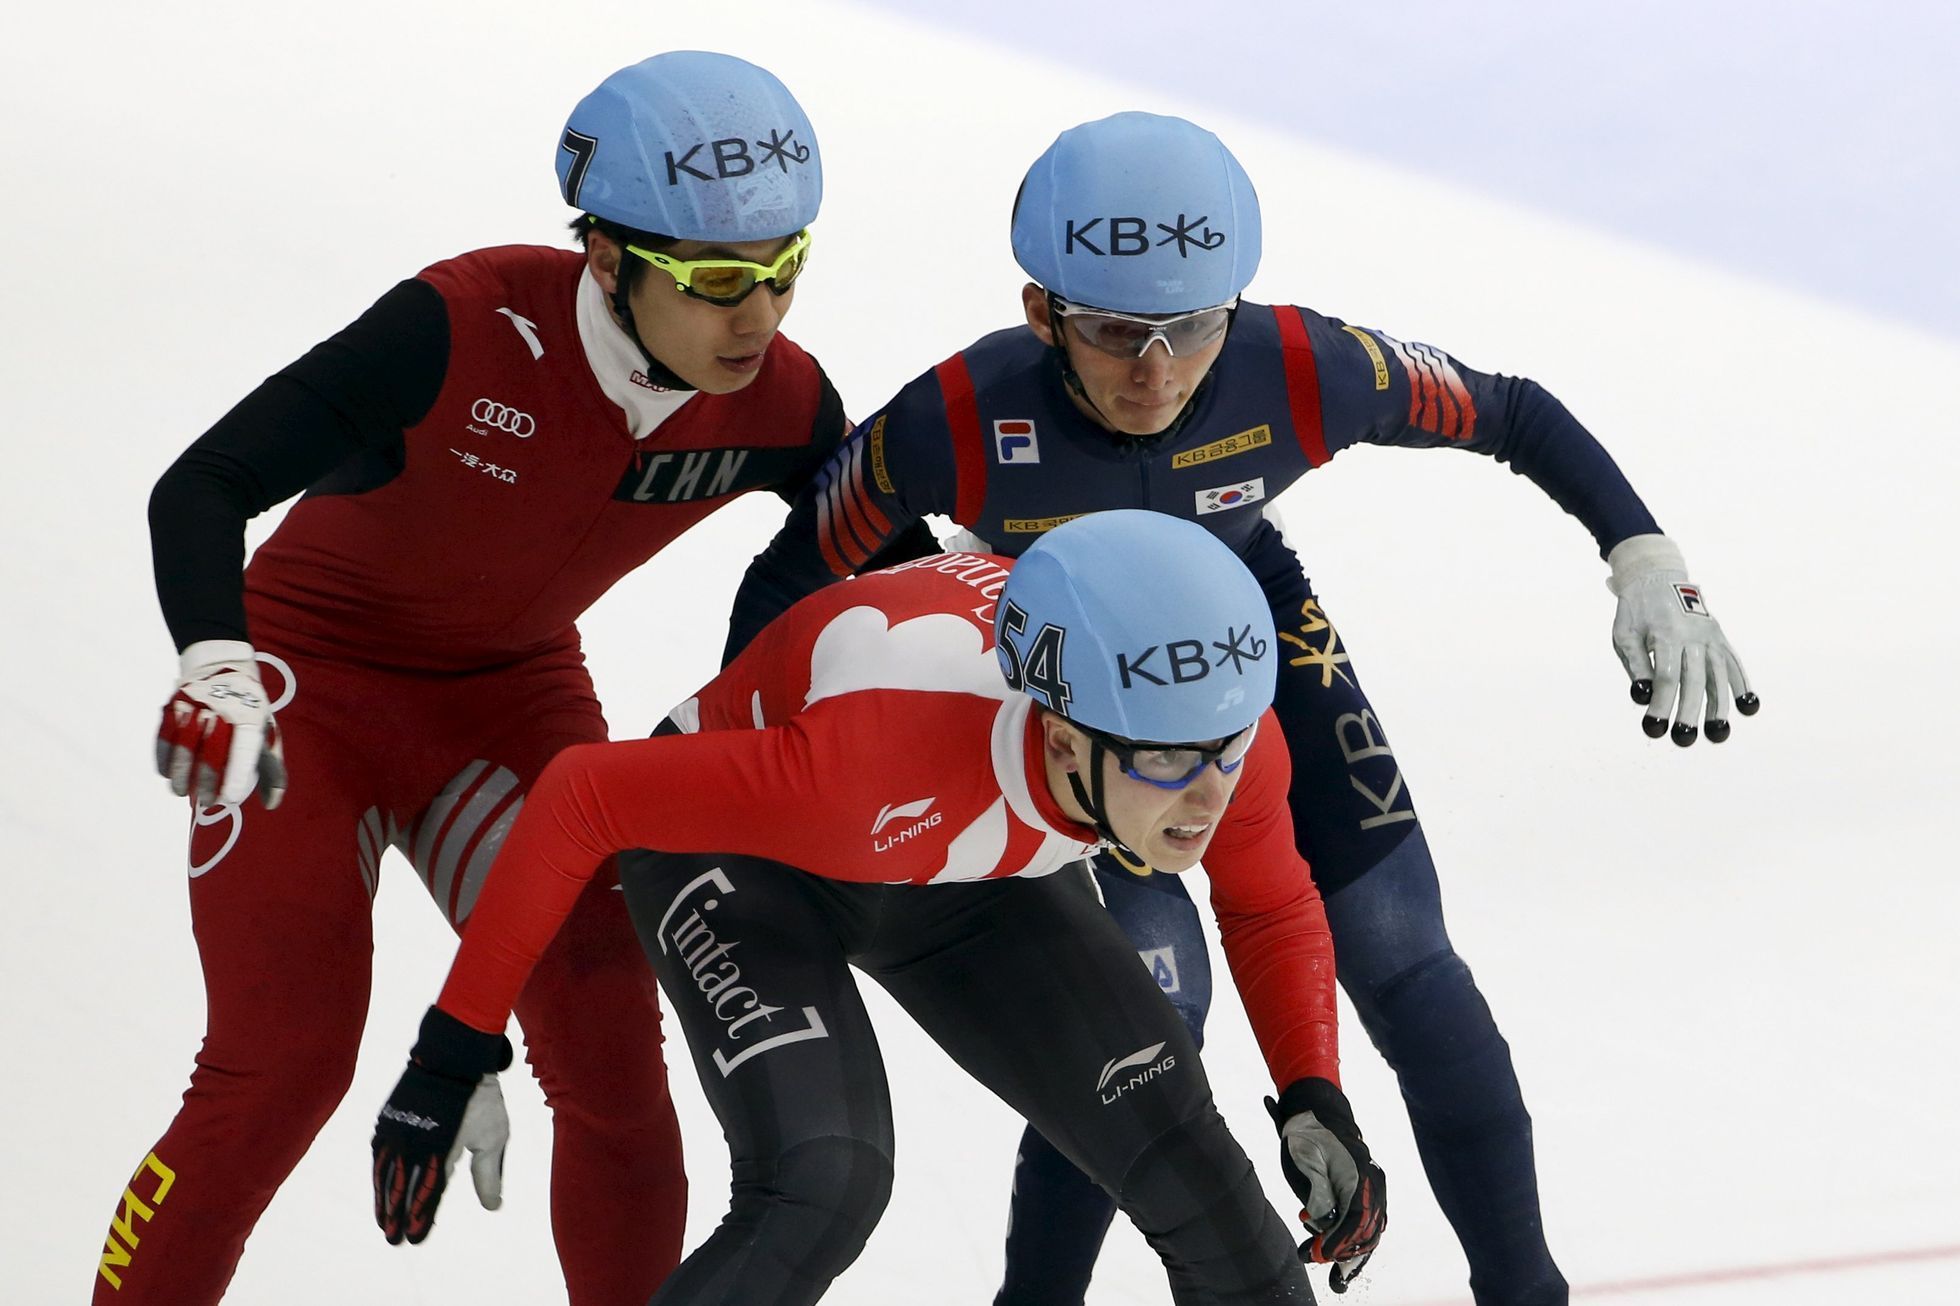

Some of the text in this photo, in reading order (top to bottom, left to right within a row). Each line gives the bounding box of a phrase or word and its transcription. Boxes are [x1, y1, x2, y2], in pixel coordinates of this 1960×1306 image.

[562, 126, 598, 208] 7
[465, 424, 489, 436] Audi
[632, 450, 749, 502] CHN
[998, 598, 1073, 717] 54
[873, 812, 942, 853] LI-NING
[1101, 1055, 1176, 1105] LI-NING
[98, 1151, 176, 1291] CHN
